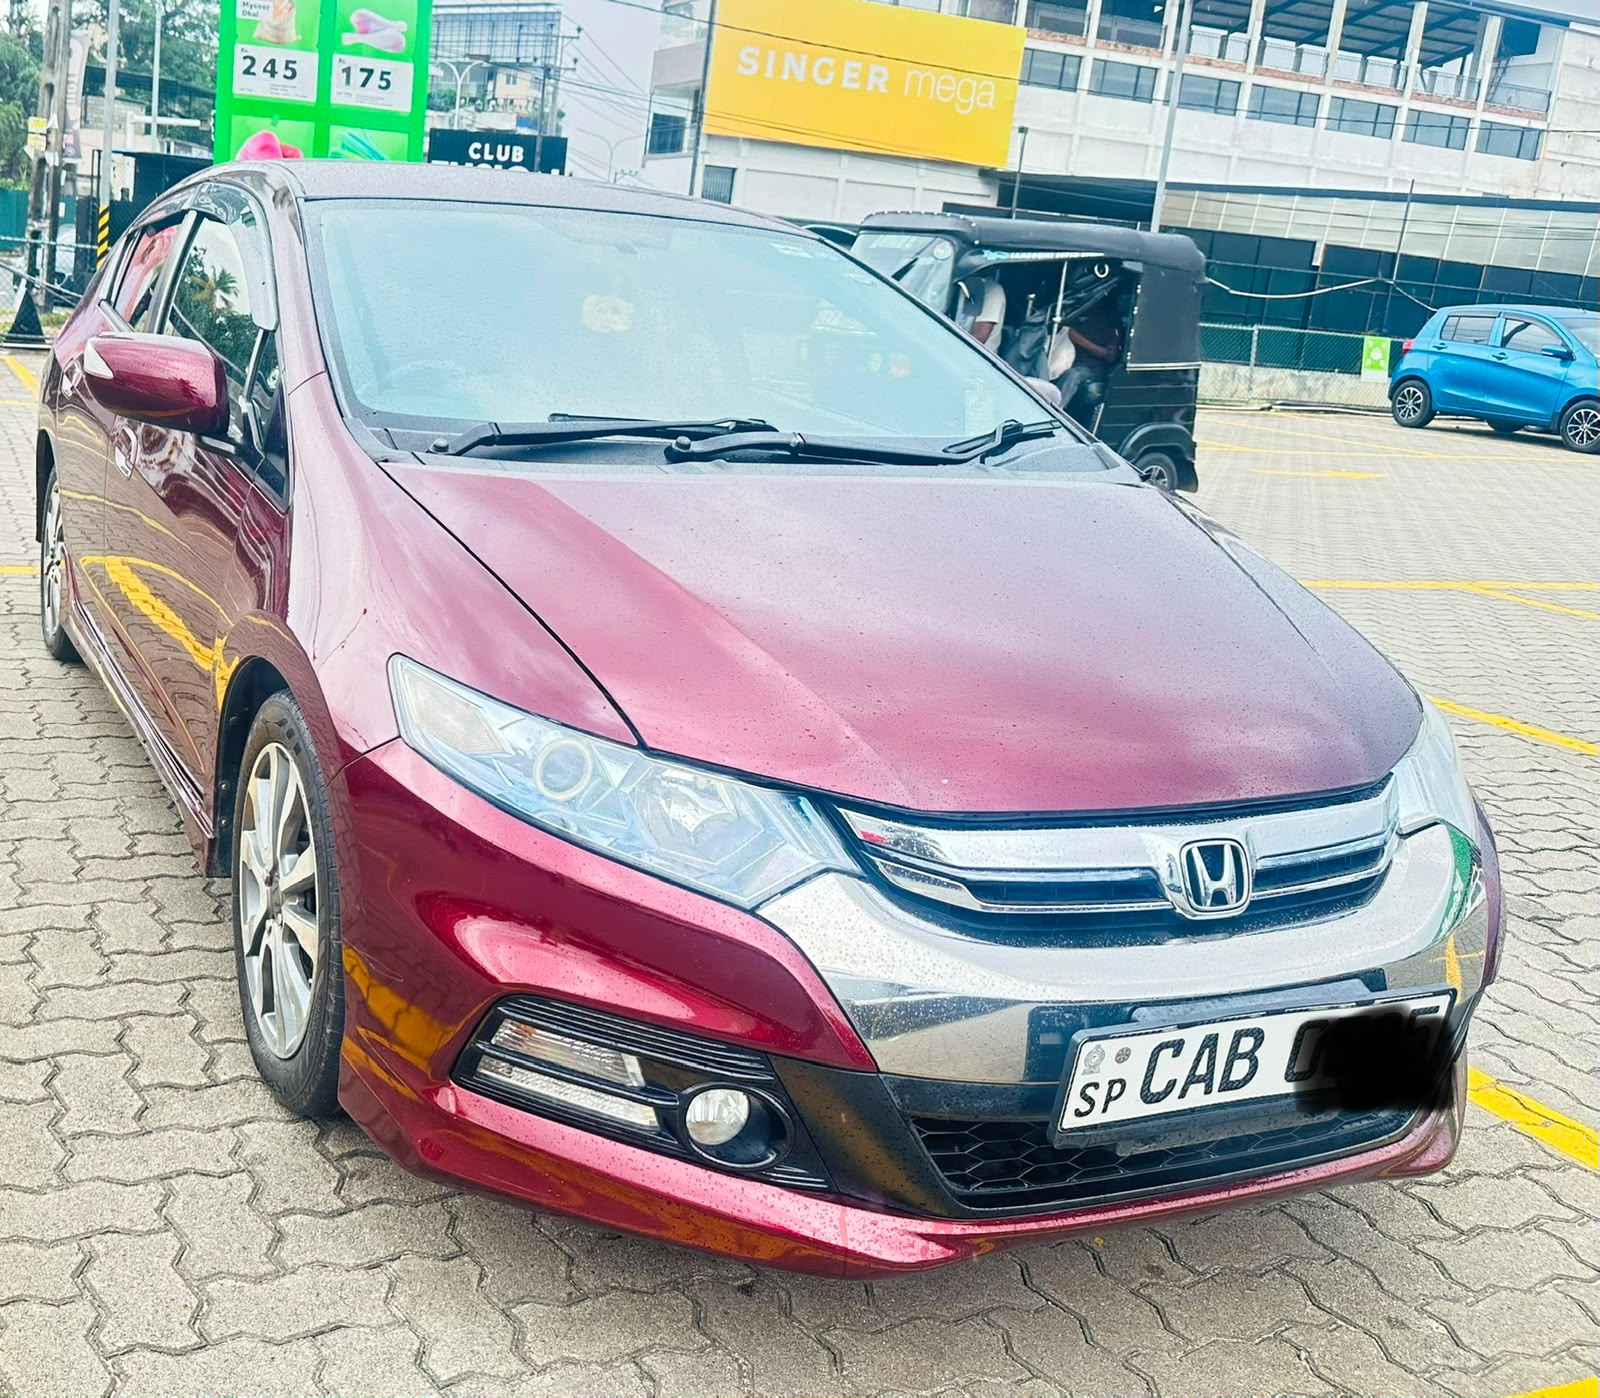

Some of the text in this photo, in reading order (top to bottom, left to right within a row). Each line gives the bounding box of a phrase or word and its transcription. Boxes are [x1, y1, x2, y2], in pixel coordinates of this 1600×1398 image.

[242, 10, 259, 18] Dhal
[242, 55, 297, 80] 245
[341, 65, 392, 91] 175
[737, 46, 996, 114] SINGER mega
[468, 142, 525, 163] CLUB
[1074, 1078, 1127, 1118] SP
[1139, 1027, 1265, 1105] CAB
